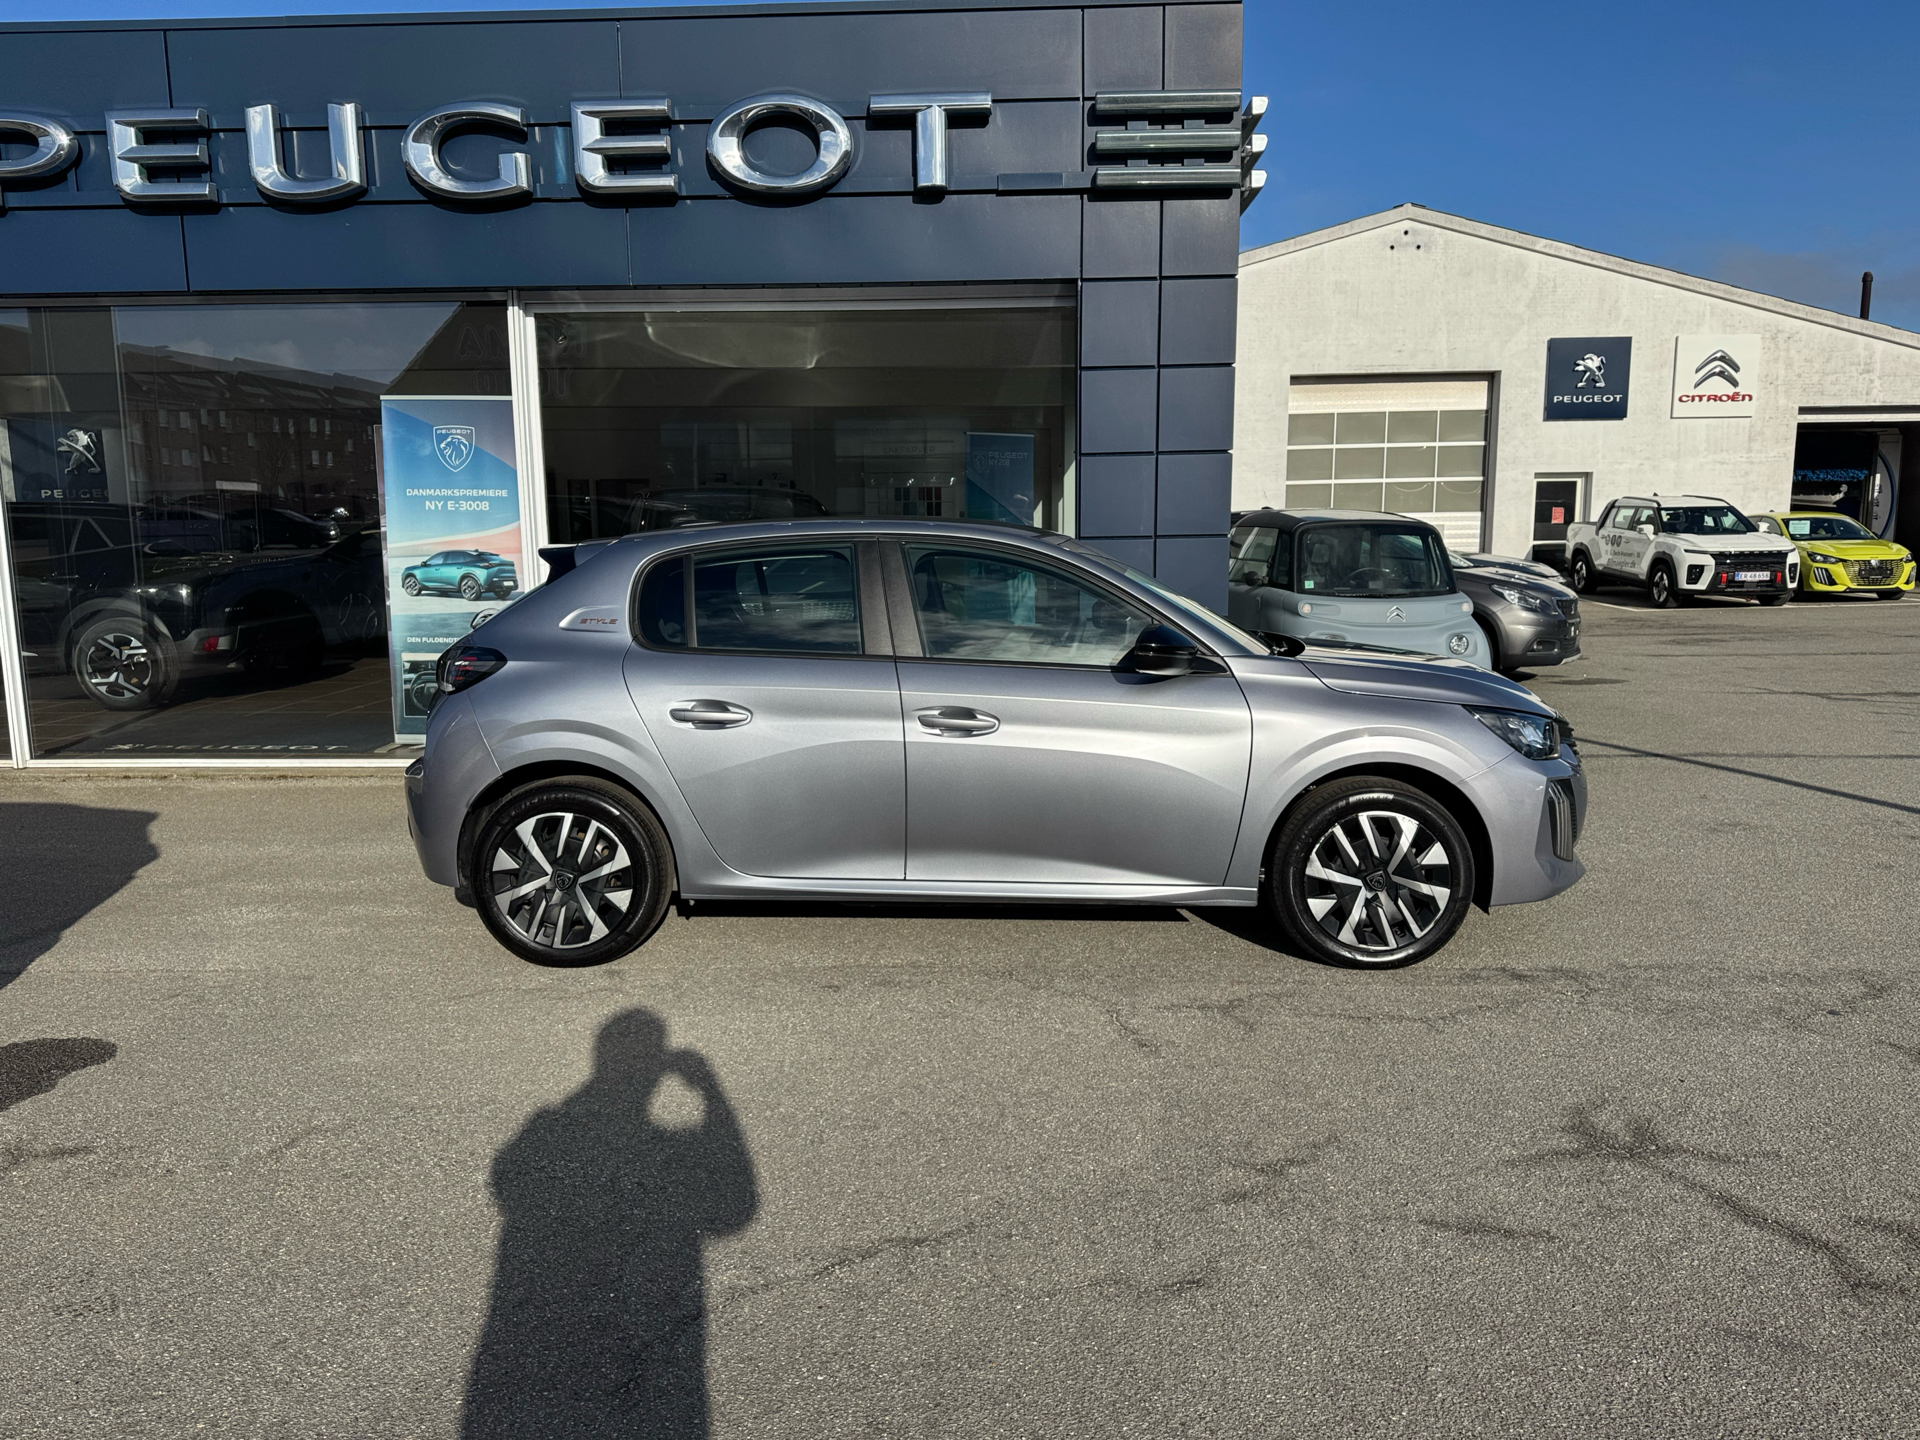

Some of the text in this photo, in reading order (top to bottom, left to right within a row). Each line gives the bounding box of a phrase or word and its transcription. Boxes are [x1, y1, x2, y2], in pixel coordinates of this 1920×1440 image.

[0, 93, 993, 204] PEUGEOT
[1553, 394, 1624, 403] PEUGEOT
[988, 451, 1029, 459] PEUGEOT
[406, 488, 508, 497] DANMARKSPREMIERE
[425, 500, 490, 511] NY E-3008
